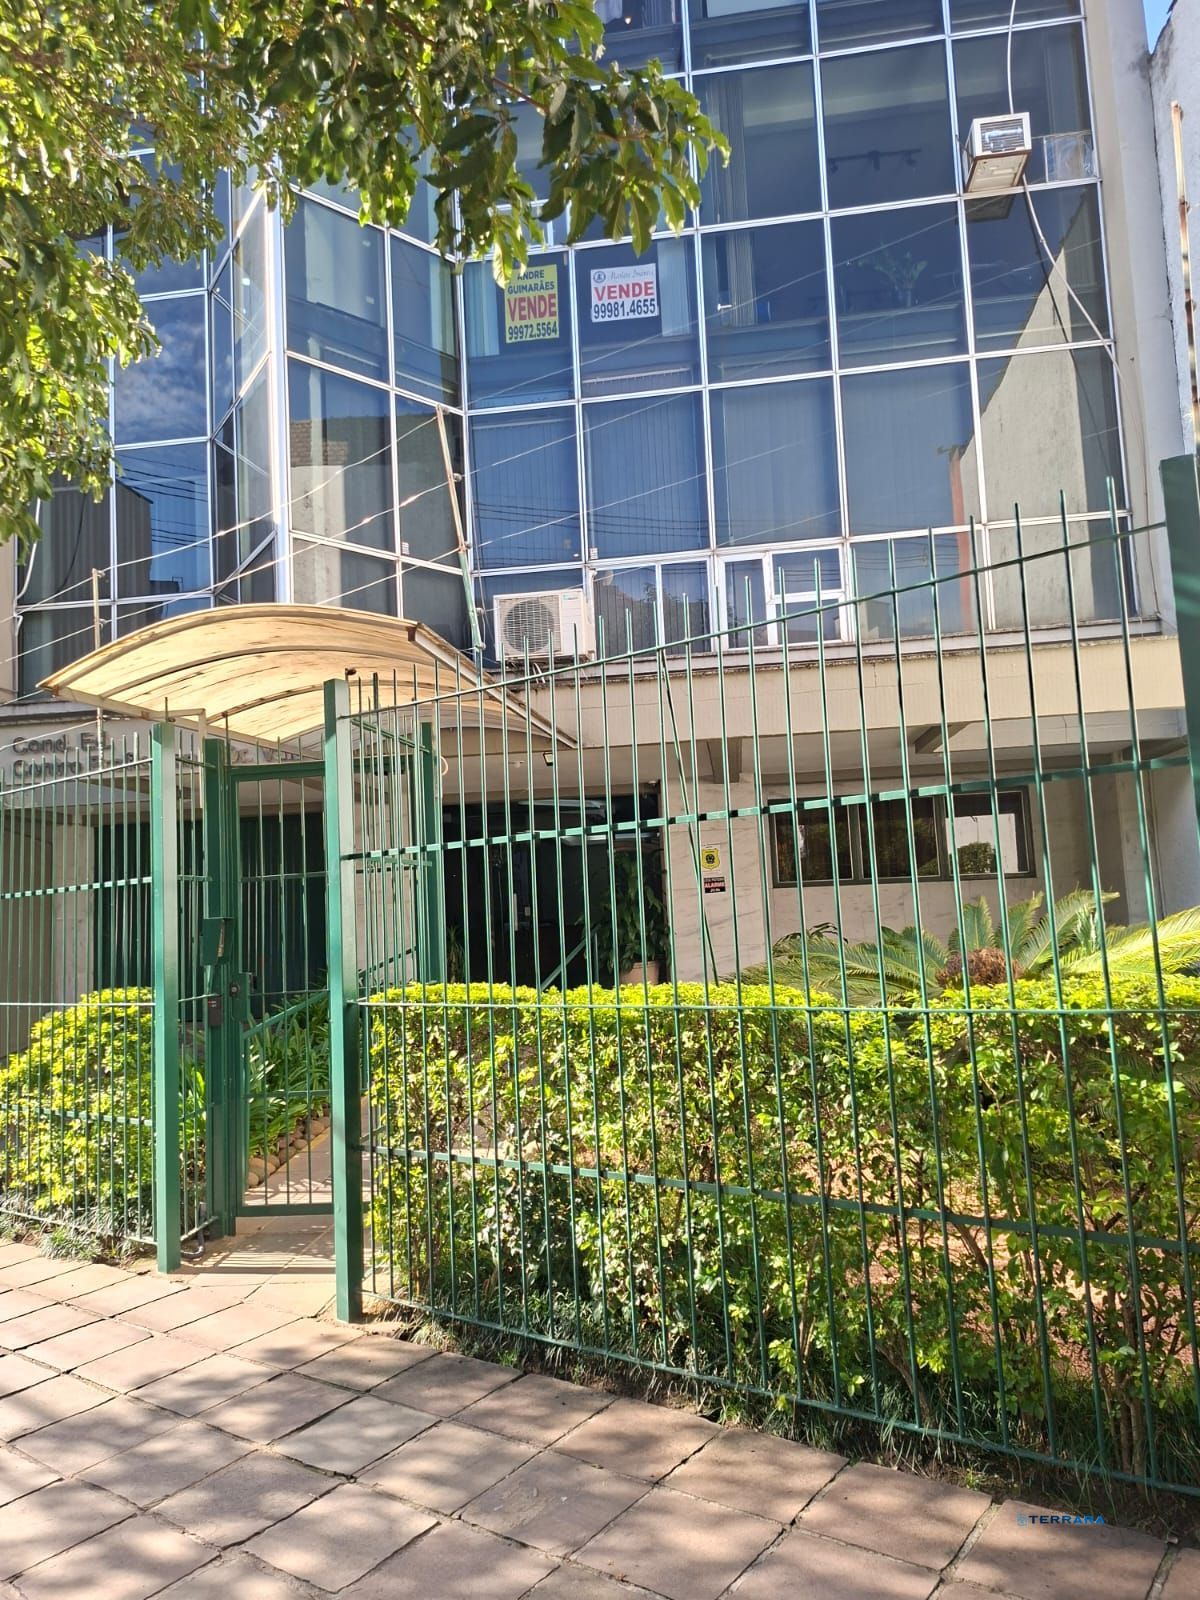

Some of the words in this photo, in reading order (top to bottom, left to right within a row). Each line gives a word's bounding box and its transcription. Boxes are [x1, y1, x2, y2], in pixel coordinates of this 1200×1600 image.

[594, 281, 654, 302] VENDE
[507, 293, 557, 322] VENDE
[593, 298, 656, 320] 99981.4655
